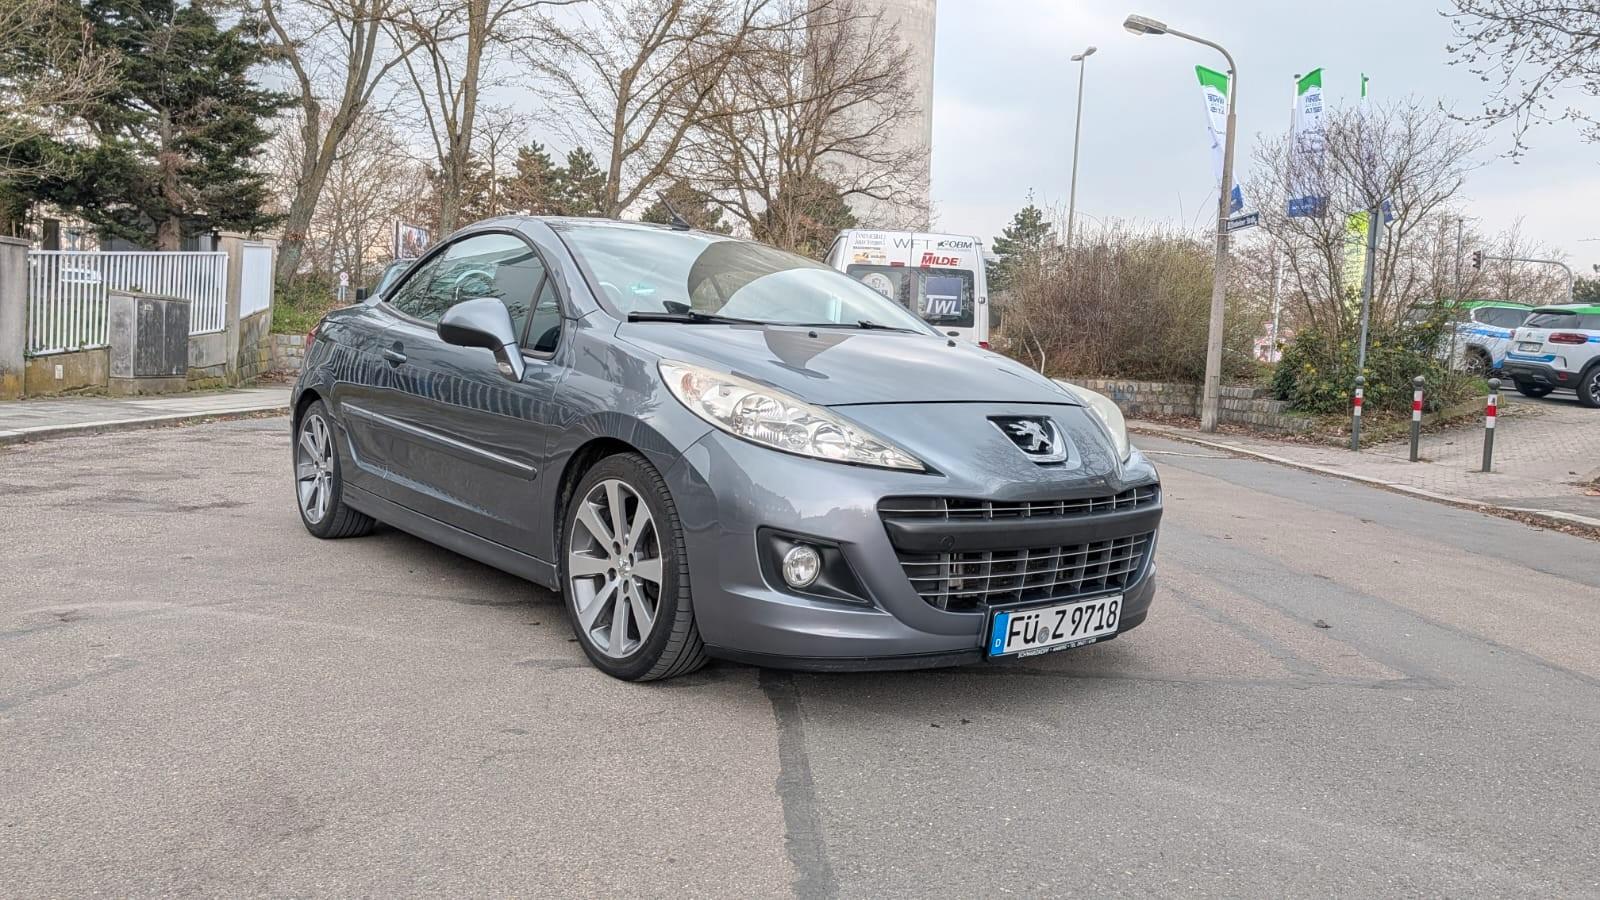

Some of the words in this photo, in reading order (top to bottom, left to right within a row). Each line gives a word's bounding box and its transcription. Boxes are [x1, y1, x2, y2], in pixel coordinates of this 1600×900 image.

[893, 238, 933, 249] WFT
[948, 240, 973, 249] OBM
[920, 255, 959, 267] MILDE
[926, 294, 960, 314] TWL
[1007, 614, 1040, 647] FÜ
[1051, 609, 1067, 639] Z
[1070, 600, 1118, 635] 9718
[995, 638, 1002, 648] D
